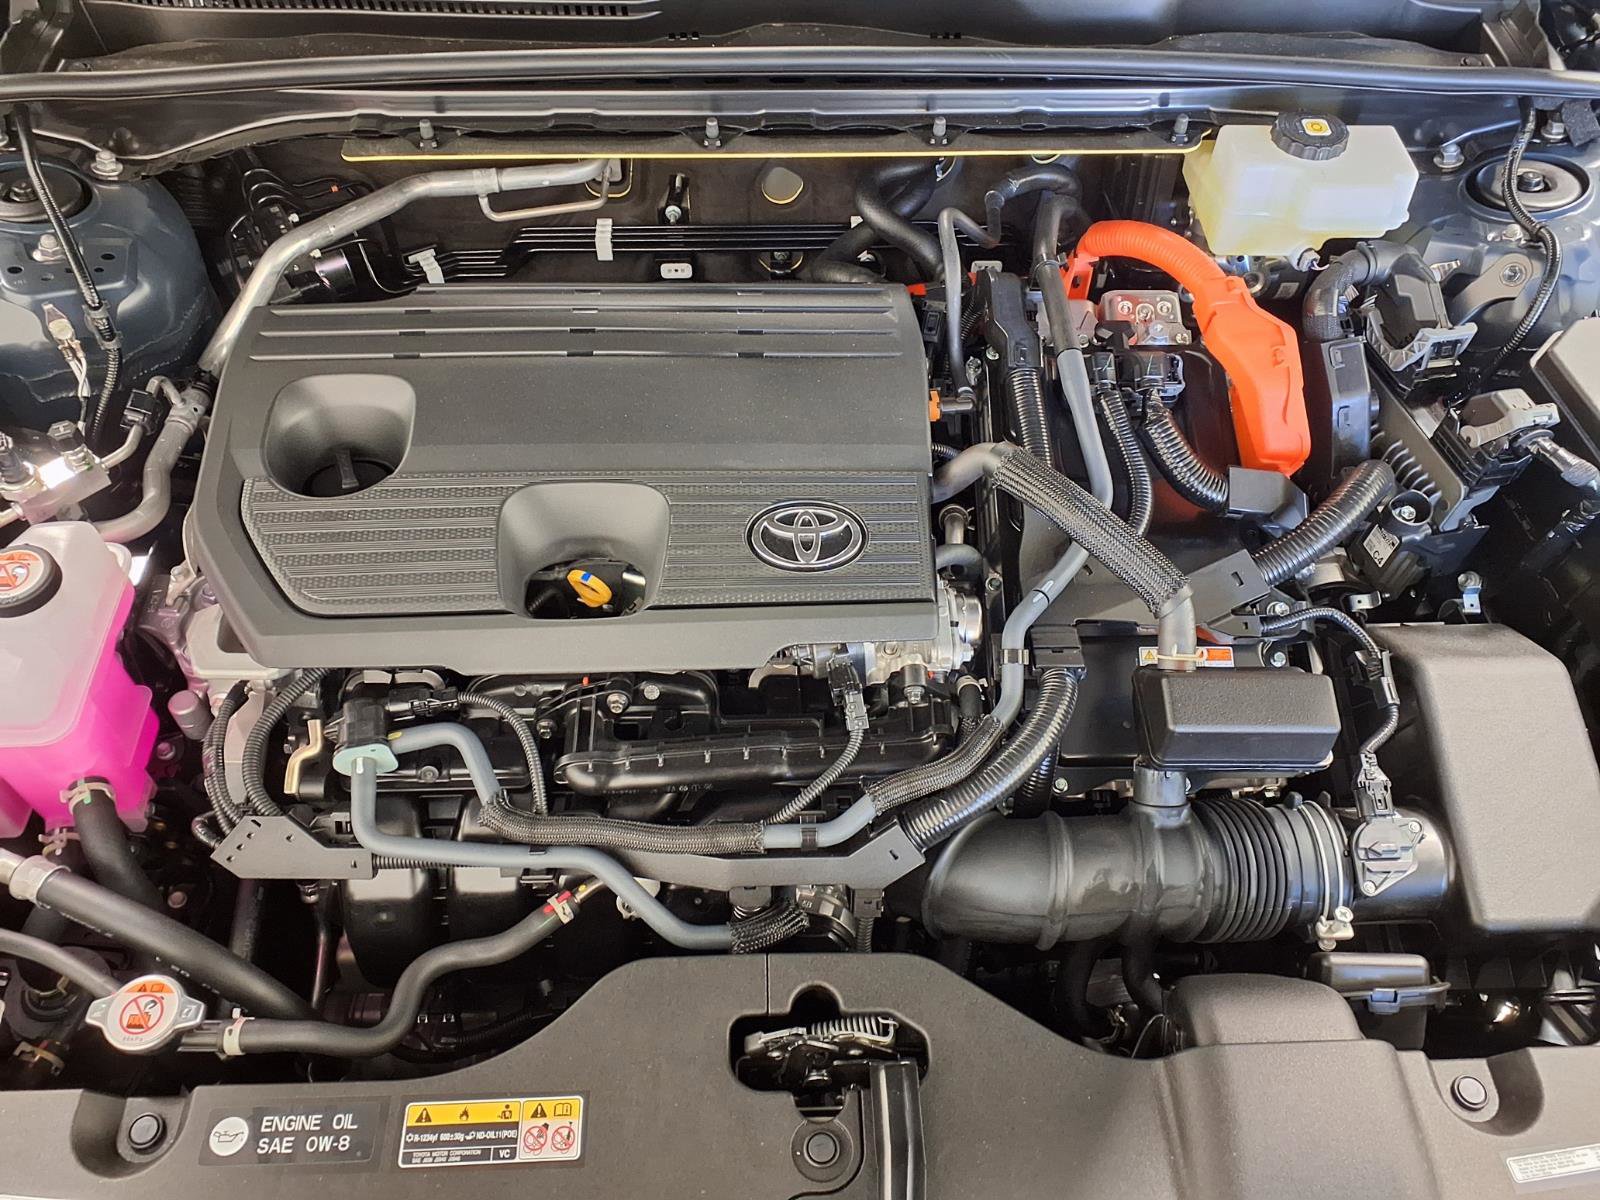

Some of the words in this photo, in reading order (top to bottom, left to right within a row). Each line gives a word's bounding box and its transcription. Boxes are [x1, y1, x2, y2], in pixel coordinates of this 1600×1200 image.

[260, 1114, 323, 1133] ENGINE
[332, 1113, 358, 1130] OIL
[256, 1136, 295, 1155] SAE
[305, 1135, 351, 1153] 0W-8
[414, 1133, 438, 1143] R-1234yf
[499, 1149, 510, 1158] VC
